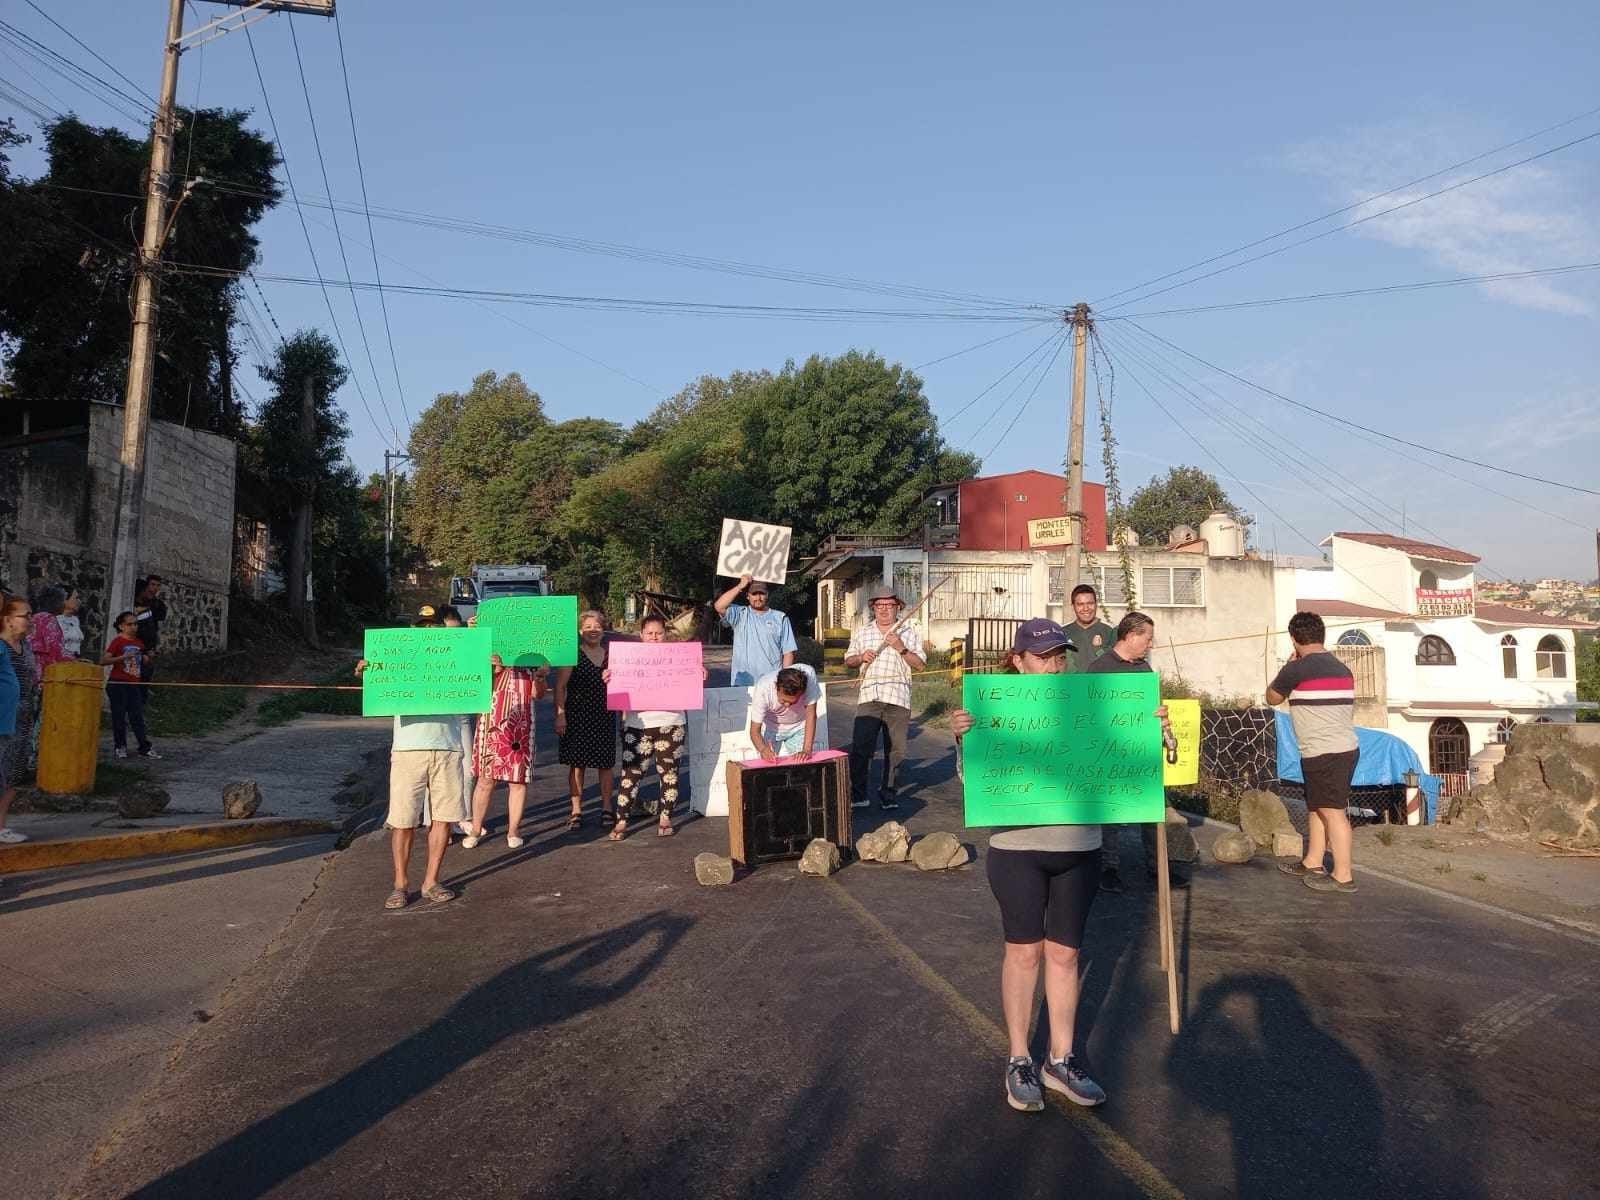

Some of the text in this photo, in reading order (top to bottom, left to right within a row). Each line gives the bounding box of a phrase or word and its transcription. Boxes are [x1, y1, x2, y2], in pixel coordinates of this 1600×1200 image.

[1036, 519, 1070, 529] MONTES
[725, 521, 790, 563] AGUA
[424, 645, 452, 656] AGUA
[425, 663, 456, 673] AGUA
[978, 681, 1145, 700] VECINOS UNIDOS
[976, 712, 1144, 732] EXIGIMOS EL AGUA
[1017, 740, 1071, 757] DIAS
[982, 764, 1024, 779] LOMAS
[1033, 764, 1056, 776] DE
[982, 782, 1034, 794] SECTOR
